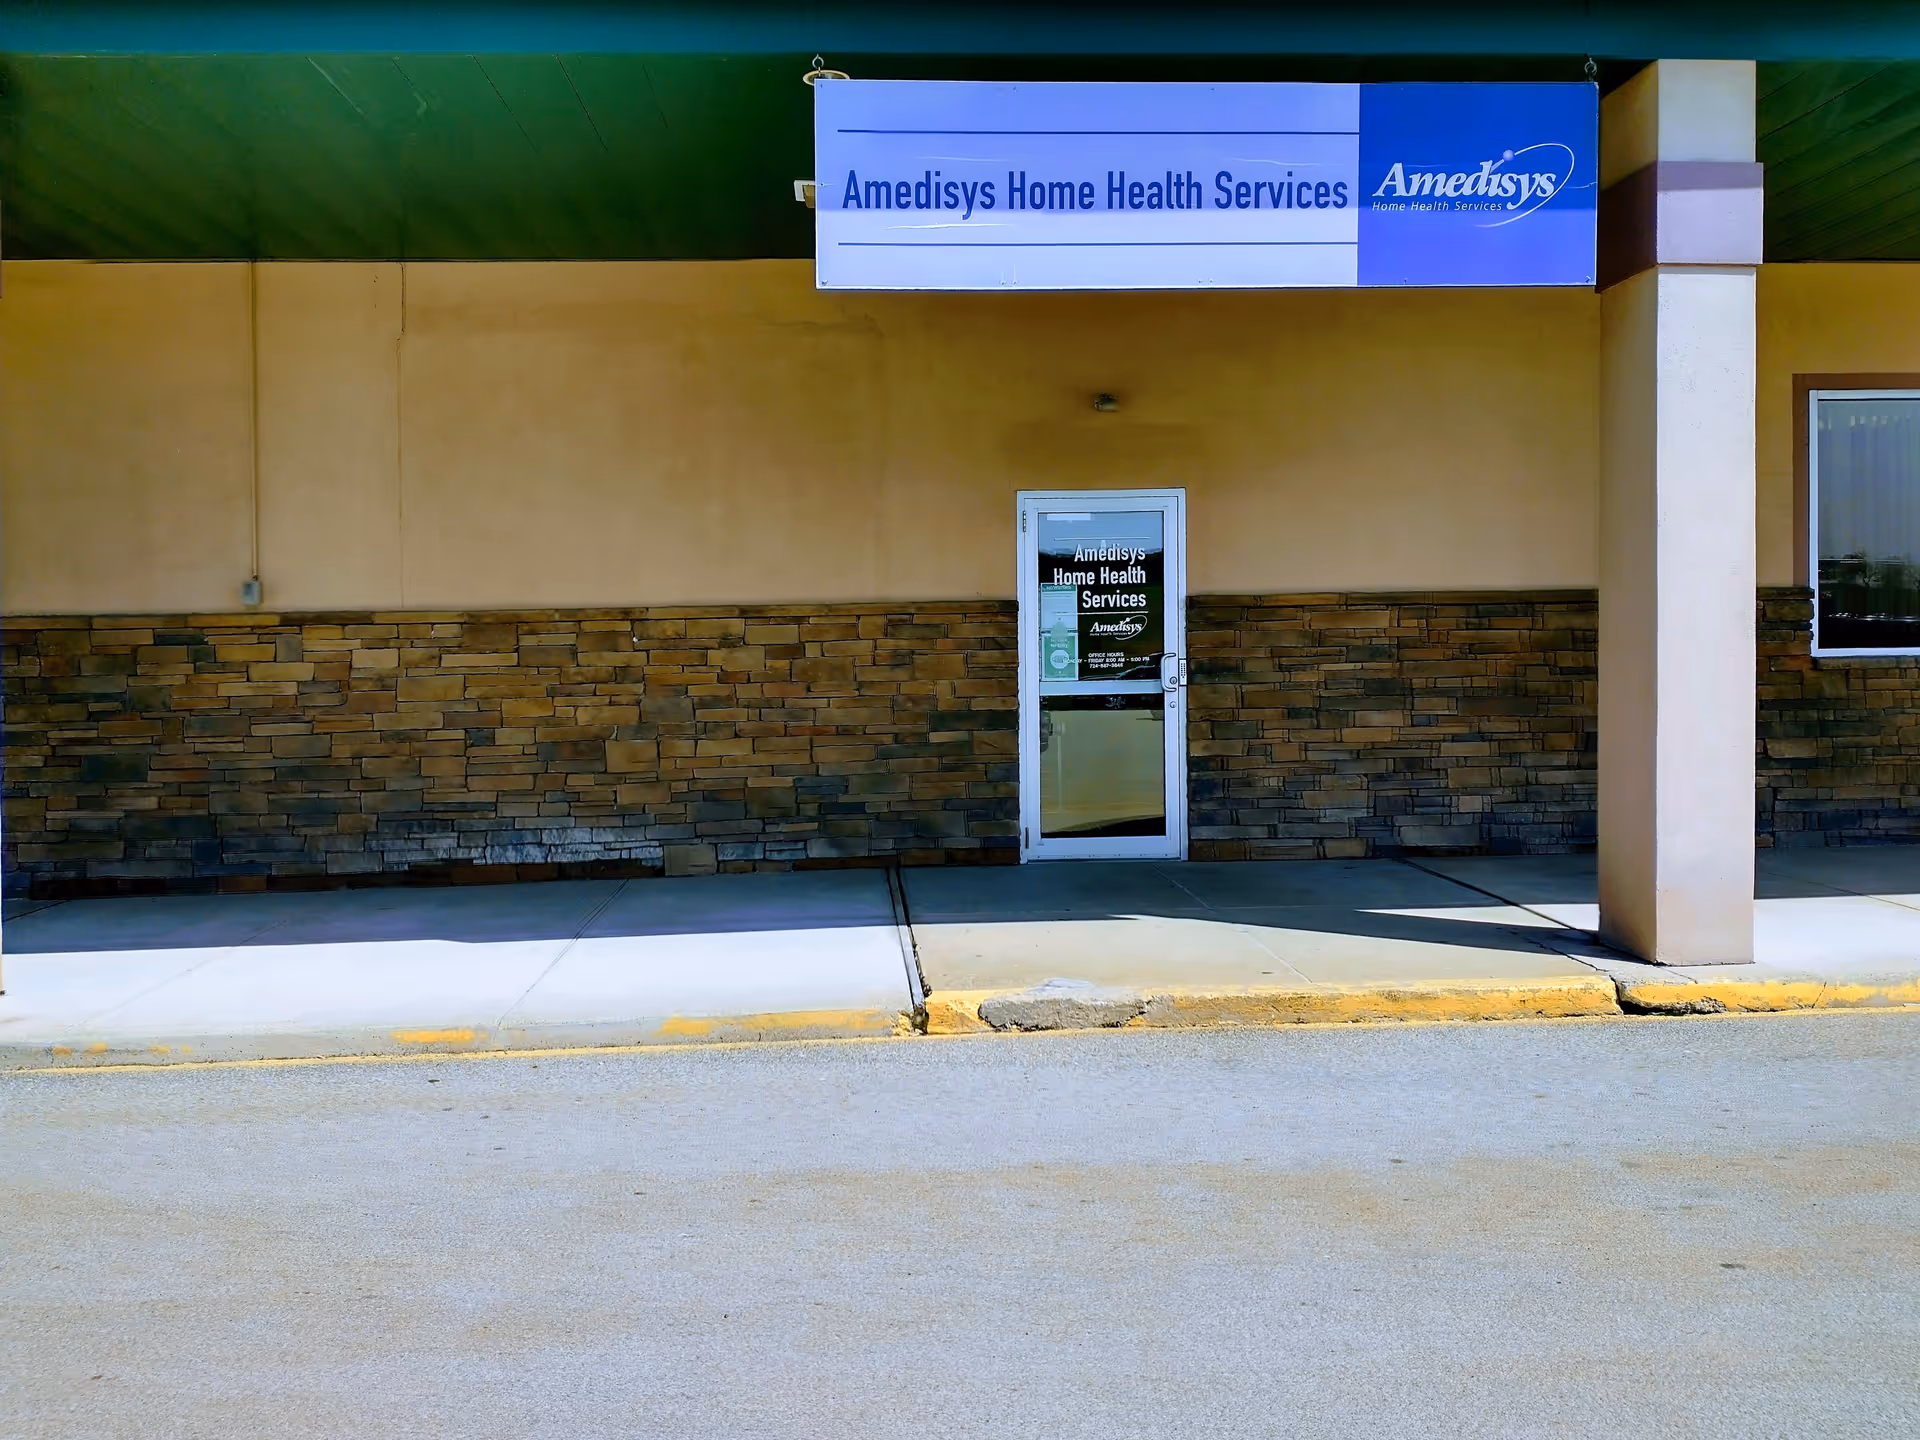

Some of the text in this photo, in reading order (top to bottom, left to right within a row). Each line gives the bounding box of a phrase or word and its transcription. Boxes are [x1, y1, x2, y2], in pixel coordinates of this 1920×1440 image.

[842, 169, 1348, 221] Amedisys Home Health Services
[1372, 160, 1556, 210] Amedisys
[1372, 201, 1502, 211] Home Health Services
[1074, 543, 1145, 565] Amedisys
[1053, 565, 1146, 586] Home Health
[1082, 590, 1146, 608] Services
[1089, 620, 1143, 635] Amedisys
